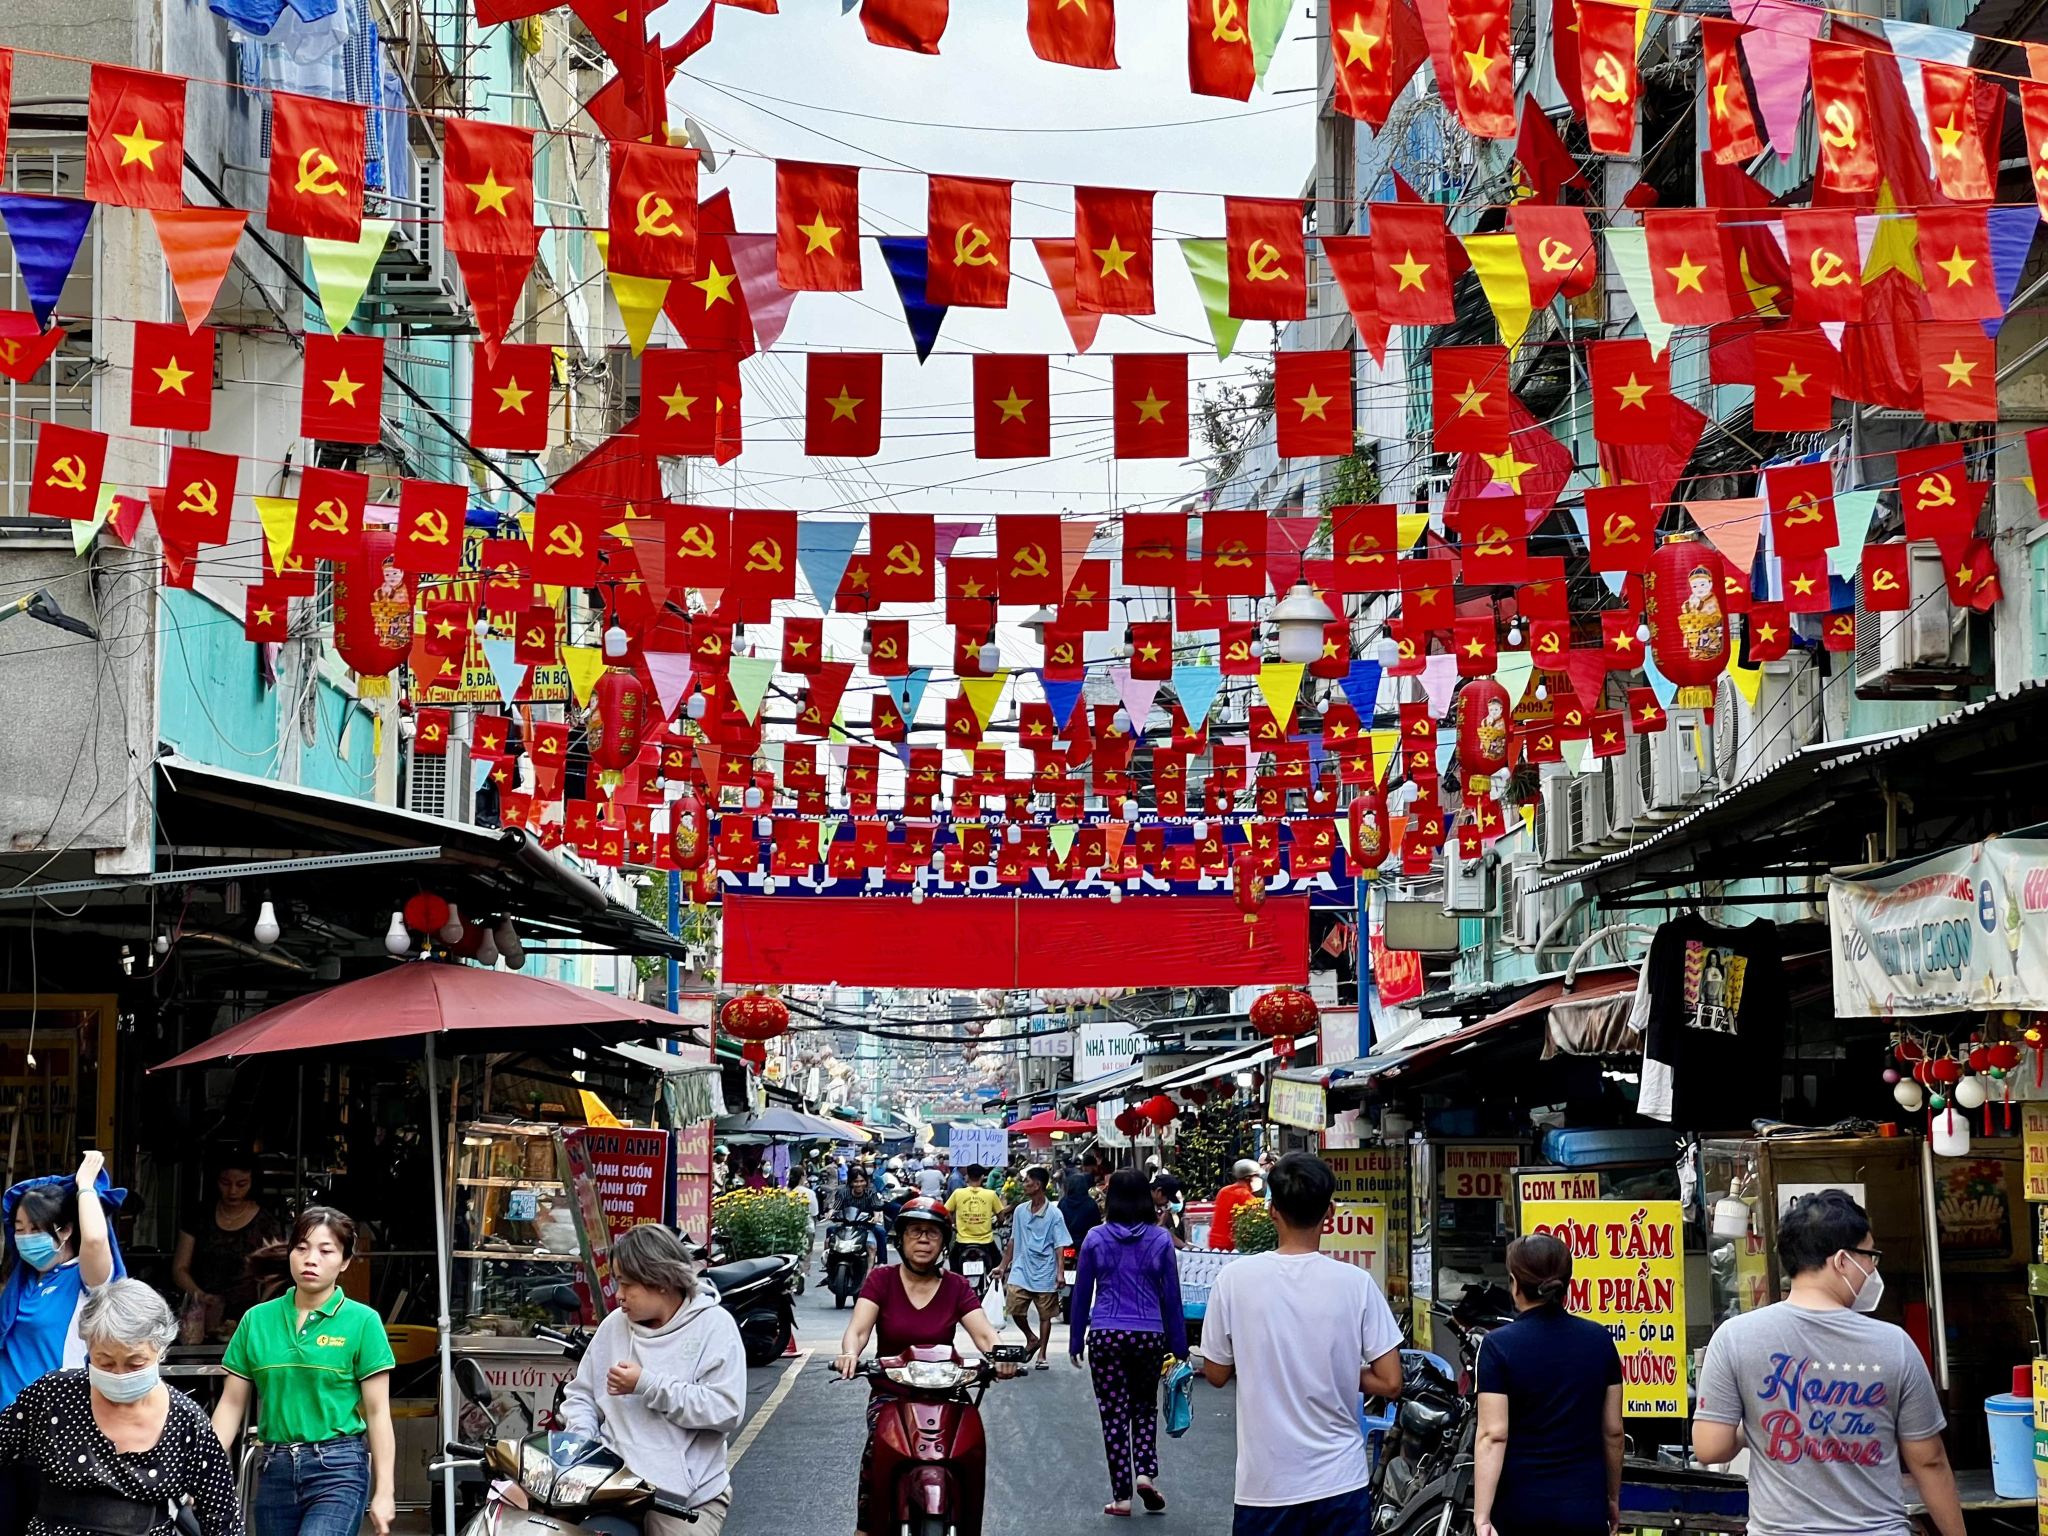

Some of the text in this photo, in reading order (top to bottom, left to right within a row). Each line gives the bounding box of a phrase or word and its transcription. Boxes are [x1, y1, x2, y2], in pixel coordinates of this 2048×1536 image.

[1033, 1038, 1068, 1055] 115
[624, 1137, 660, 1157] ANH
[598, 1181, 624, 1195] ÁNH
[1561, 1174, 1596, 1200] TẤM
[603, 1197, 634, 1212] NÓNG
[1321, 1210, 1374, 1236] BÚN
[1606, 1208, 1675, 1259] TẤM
[1598, 1261, 1675, 1314] PHẦN
[1639, 1318, 1657, 1342] ỐP
[1660, 1324, 1674, 1342] LA
[512, 1366, 546, 1388] ƯỚT
[1757, 1352, 1889, 1414] Home
[1808, 1409, 1877, 1436] Of The
[1760, 1409, 1885, 1468] Brave
